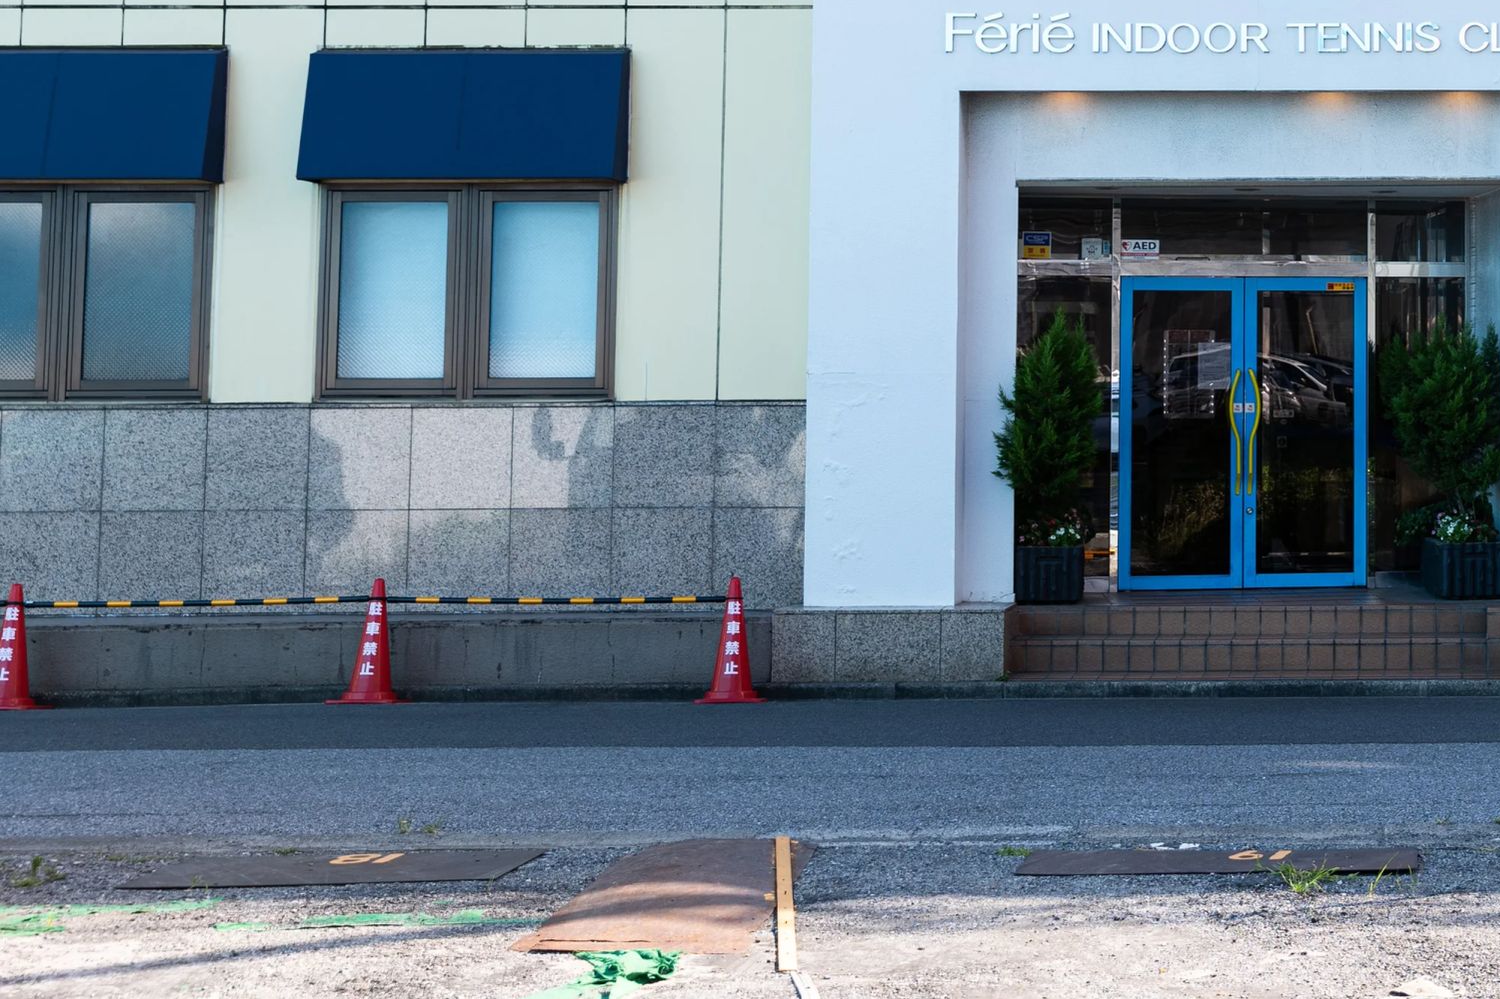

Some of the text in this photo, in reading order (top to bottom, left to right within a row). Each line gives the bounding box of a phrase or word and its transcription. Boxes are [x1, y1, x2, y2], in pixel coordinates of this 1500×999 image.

[944, 11, 1076, 54] Férié
[1091, 21, 1270, 54] INDOOR
[1285, 21, 1441, 54] TENNIS
[1132, 241, 1157, 250] AED
[359, 601, 383, 676] 駐車禁止
[723, 601, 742, 675] 駐車禁止
